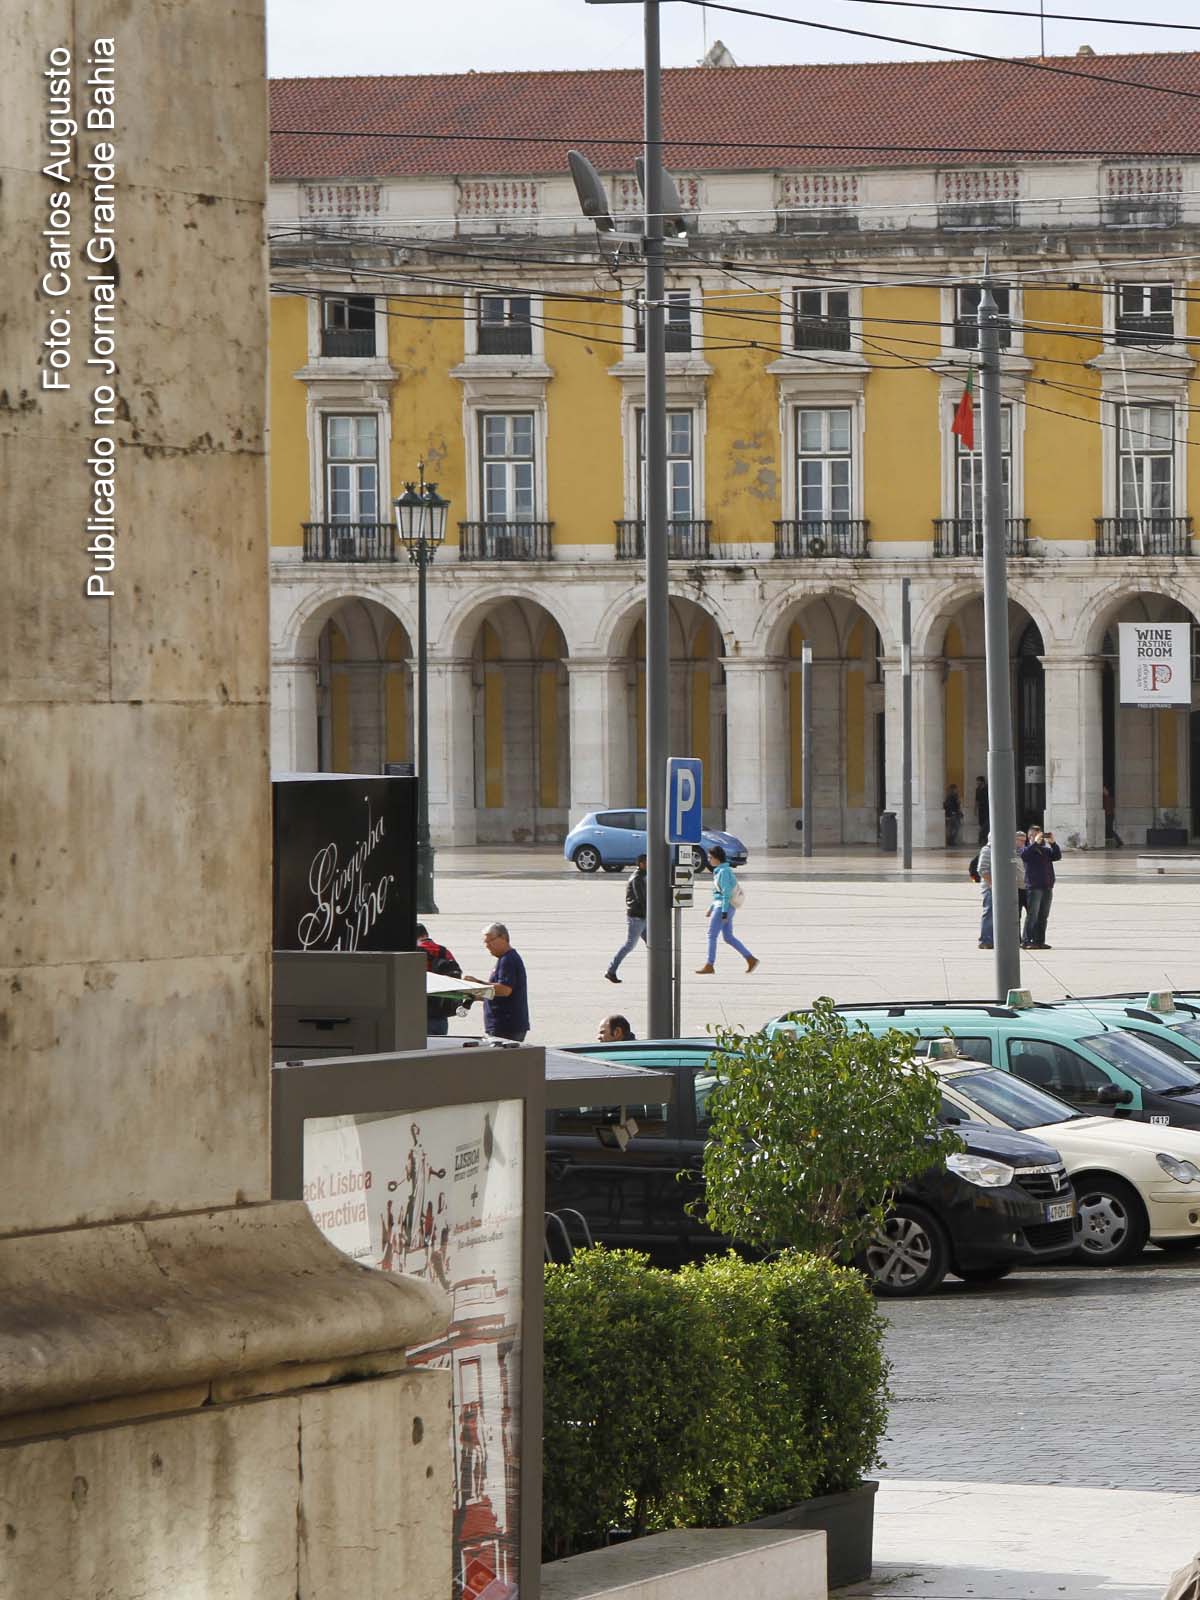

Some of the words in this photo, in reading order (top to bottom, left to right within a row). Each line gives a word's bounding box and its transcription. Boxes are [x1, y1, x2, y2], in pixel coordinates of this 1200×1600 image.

[1134, 627, 1172, 640] WINE
[1137, 647, 1172, 657] ROOM
[676, 768, 696, 836] P
[1152, 1116, 1169, 1125] 1412
[330, 1168, 372, 1197] Lisboa
